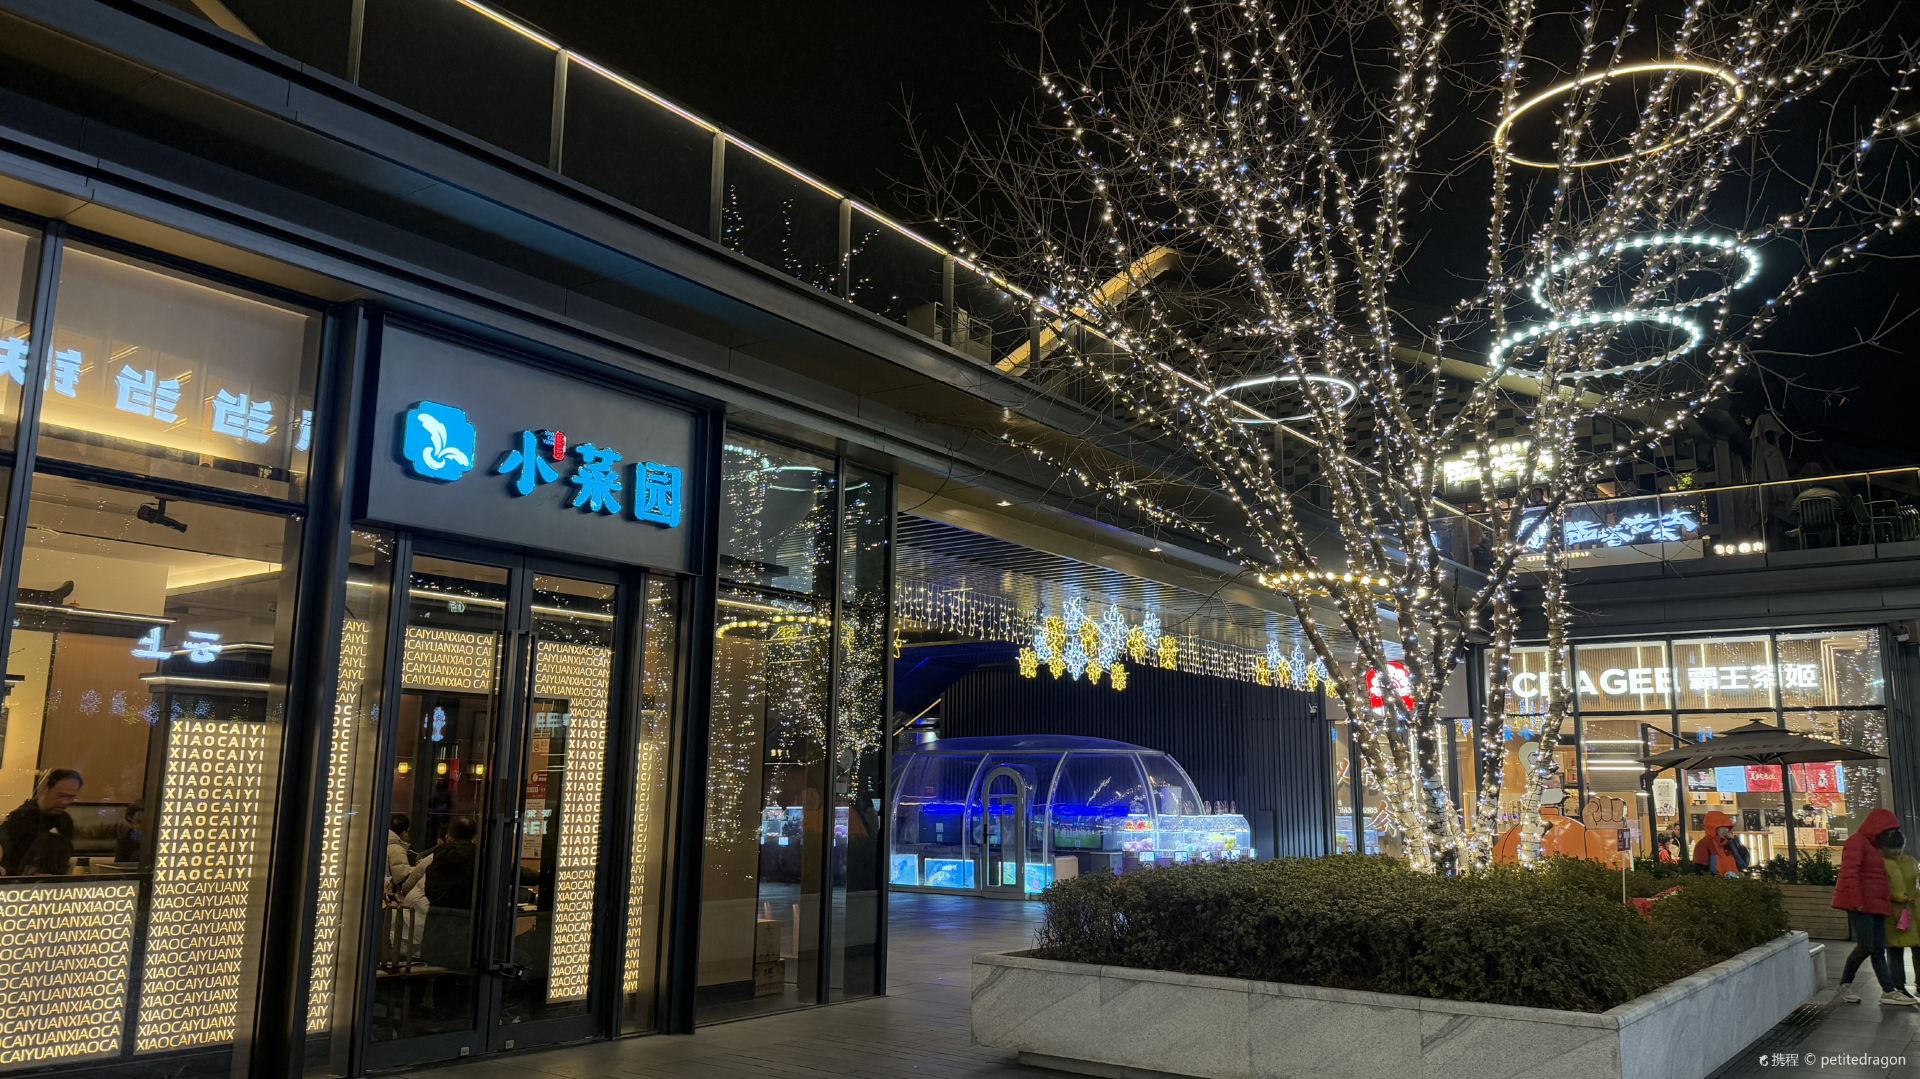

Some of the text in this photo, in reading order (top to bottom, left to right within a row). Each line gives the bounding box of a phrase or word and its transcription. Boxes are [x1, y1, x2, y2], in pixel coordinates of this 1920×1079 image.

[497, 430, 682, 528] 小菜园
[1688, 663, 1818, 690] 霸王茶姬
[0, 914, 132, 931] OCAIYUANXIAOCA
[0, 1011, 121, 1034] CAIYUANXIAOCA
